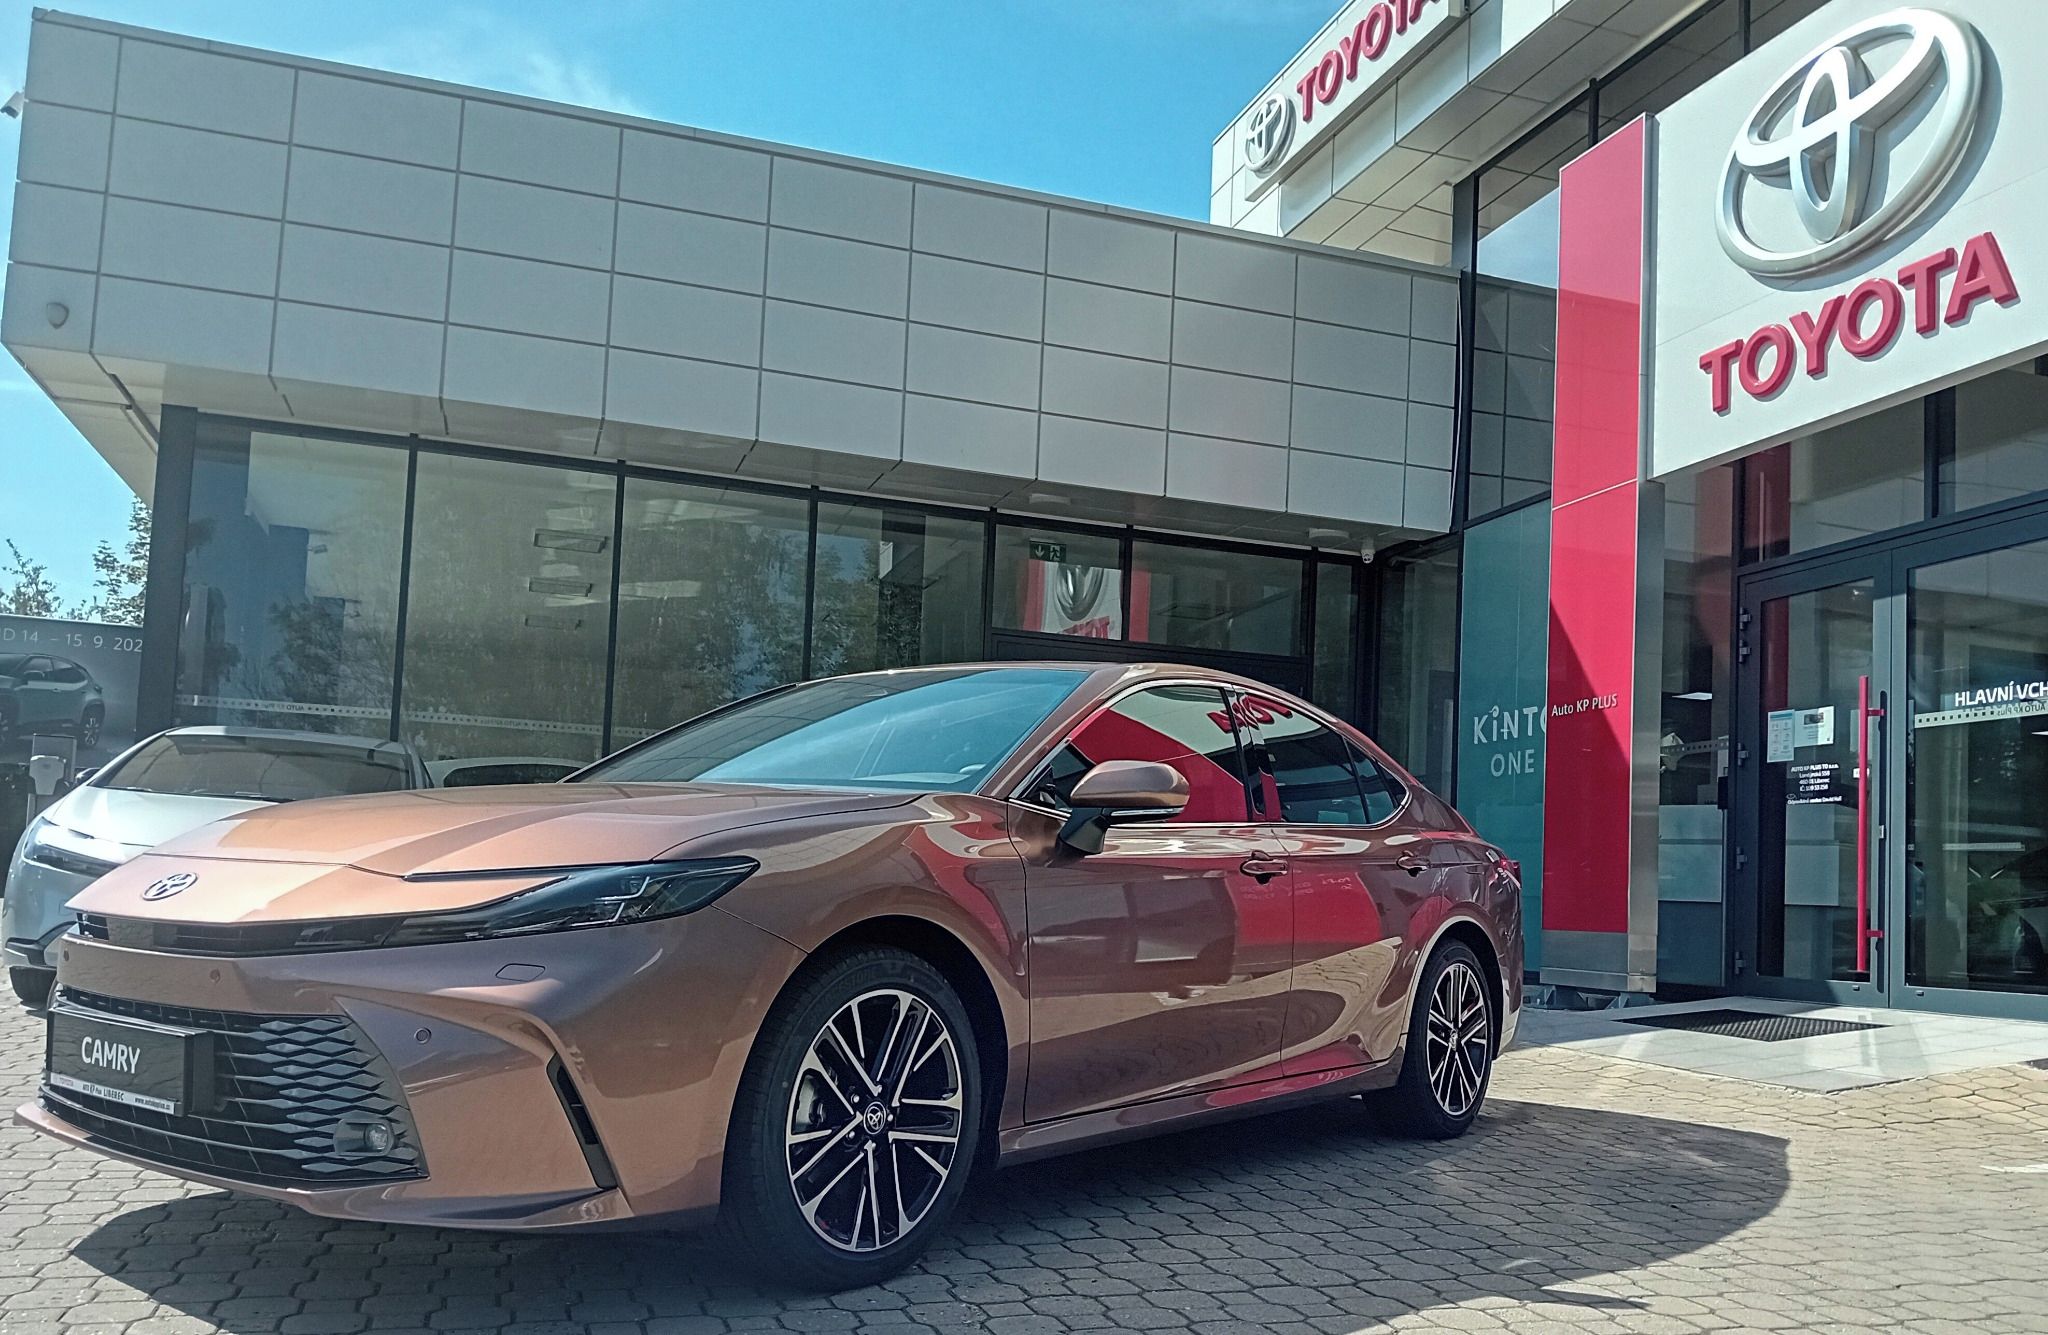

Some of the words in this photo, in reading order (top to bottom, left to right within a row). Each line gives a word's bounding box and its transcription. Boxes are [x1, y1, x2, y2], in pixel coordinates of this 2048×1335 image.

[1699, 231, 2019, 412] TOYOTA
[1551, 704, 1574, 717] Auto
[1576, 699, 1590, 713] KP
[1591, 693, 1618, 710] PLUS
[1955, 680, 2014, 707] HLAVNÍ
[1490, 749, 1535, 777] ONE
[81, 1036, 141, 1074] CAMRY
[103, 1088, 124, 1101] LIBEREC
